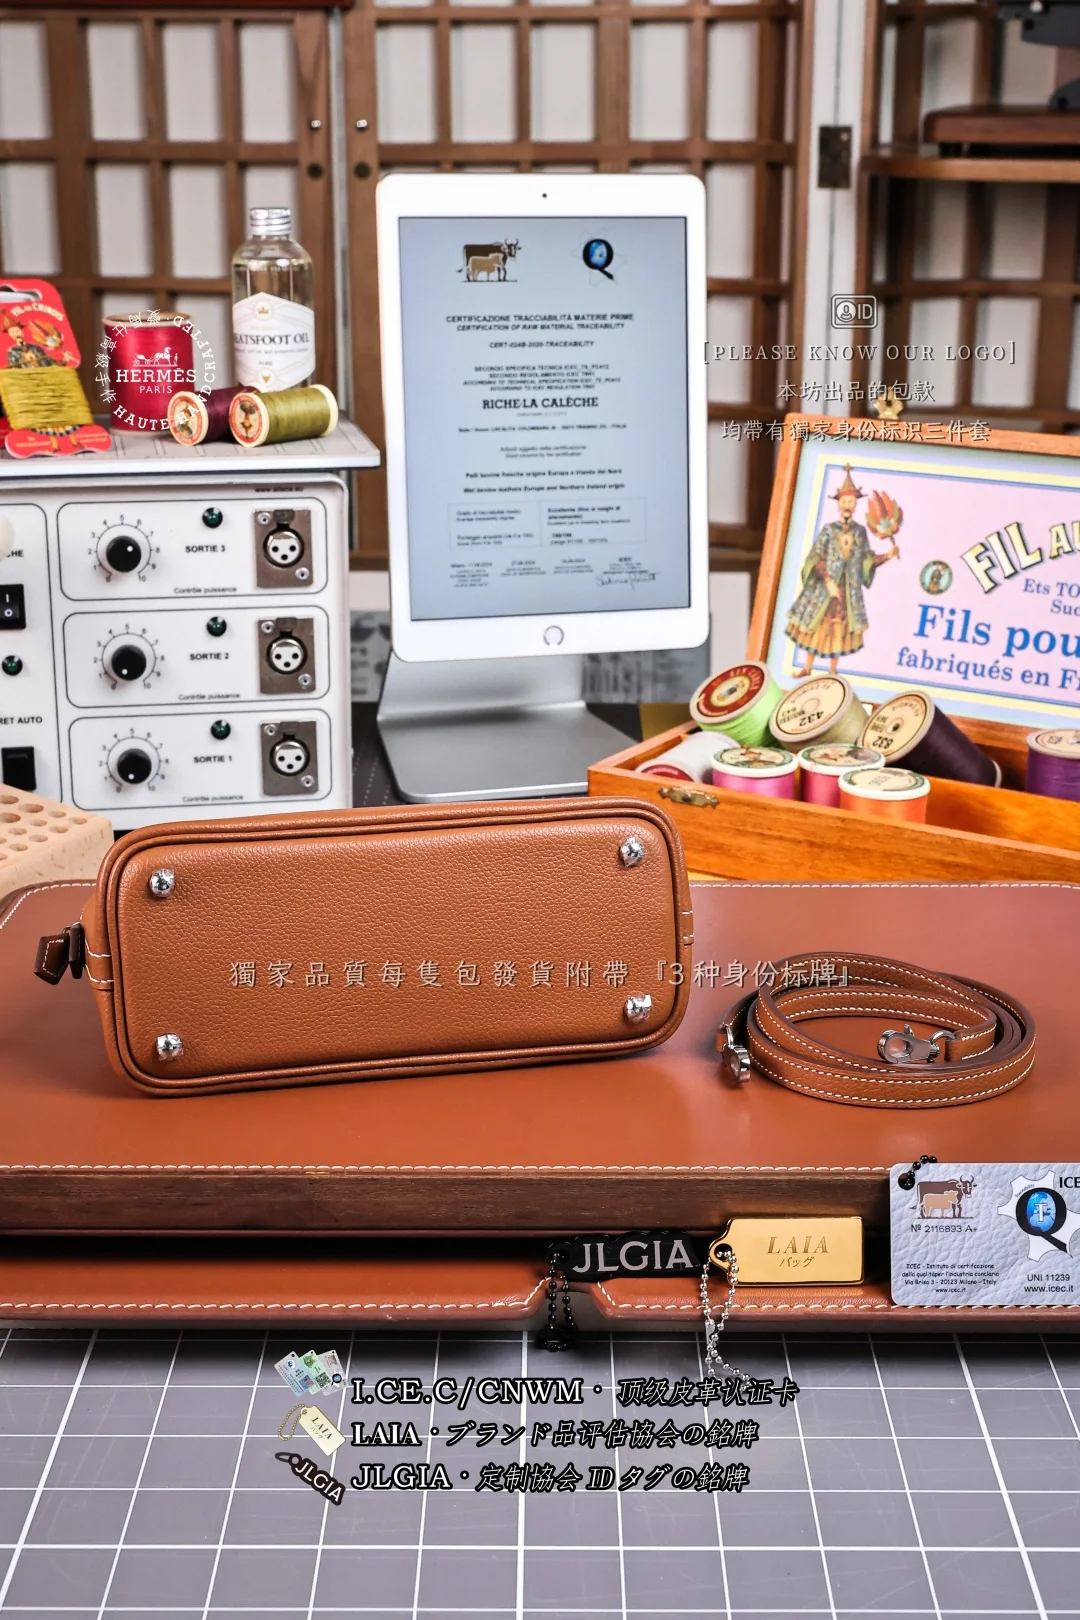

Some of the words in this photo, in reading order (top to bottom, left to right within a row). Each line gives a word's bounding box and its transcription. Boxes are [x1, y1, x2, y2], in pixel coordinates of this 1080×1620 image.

[445, 315, 510, 324] CERTIFICAZIONE
[513, 313, 571, 322] TRACCIABILITÀ
[573, 313, 607, 321] MATERIE
[609, 312, 634, 321] PRIME
[456, 324, 509, 332] CERTIFICATION
[511, 323, 519, 331] OF
[521, 323, 538, 331] RAW
[540, 323, 574, 331] MATERIAL
[576, 322, 625, 330] TRACEABILITY
[293, 332, 309, 344] OIL
[482, 399, 521, 410] RICHE
[522, 398, 538, 409] LA
[541, 395, 599, 408] CALÈCHE
[185, 545, 218, 553] SORTIE
[961, 521, 1043, 595] FIL
[204, 586, 237, 594] puissance
[1023, 579, 1051, 595] Ets
[1050, 600, 1080, 617] Suc
[913, 604, 992, 646] Fils
[1002, 625, 1080, 659] pou
[190, 653, 222, 661] SORTIE
[896, 646, 1013, 681] fabriqués
[1021, 669, 1050, 686] en
[178, 693, 206, 701] Contrôle
[208, 692, 241, 701] puissance
[17, 716, 43, 725] AUTO
[193, 756, 225, 764] SORTIE
[212, 794, 244, 803] puissance
[1059, 1177, 1080, 1188] ICE
[924, 1225, 962, 1233] 2116893
[965, 1225, 978, 1233] A+
[767, 1236, 829, 1254] LAIA
[572, 1239, 694, 1273] JLGIA
[779, 1256, 815, 1268] バッグ
[982, 1279, 997, 1287] Italy
[1027, 1274, 1043, 1282] UNI
[1045, 1274, 1071, 1282] 11239
[1024, 1285, 1074, 1293] www.icec.it
